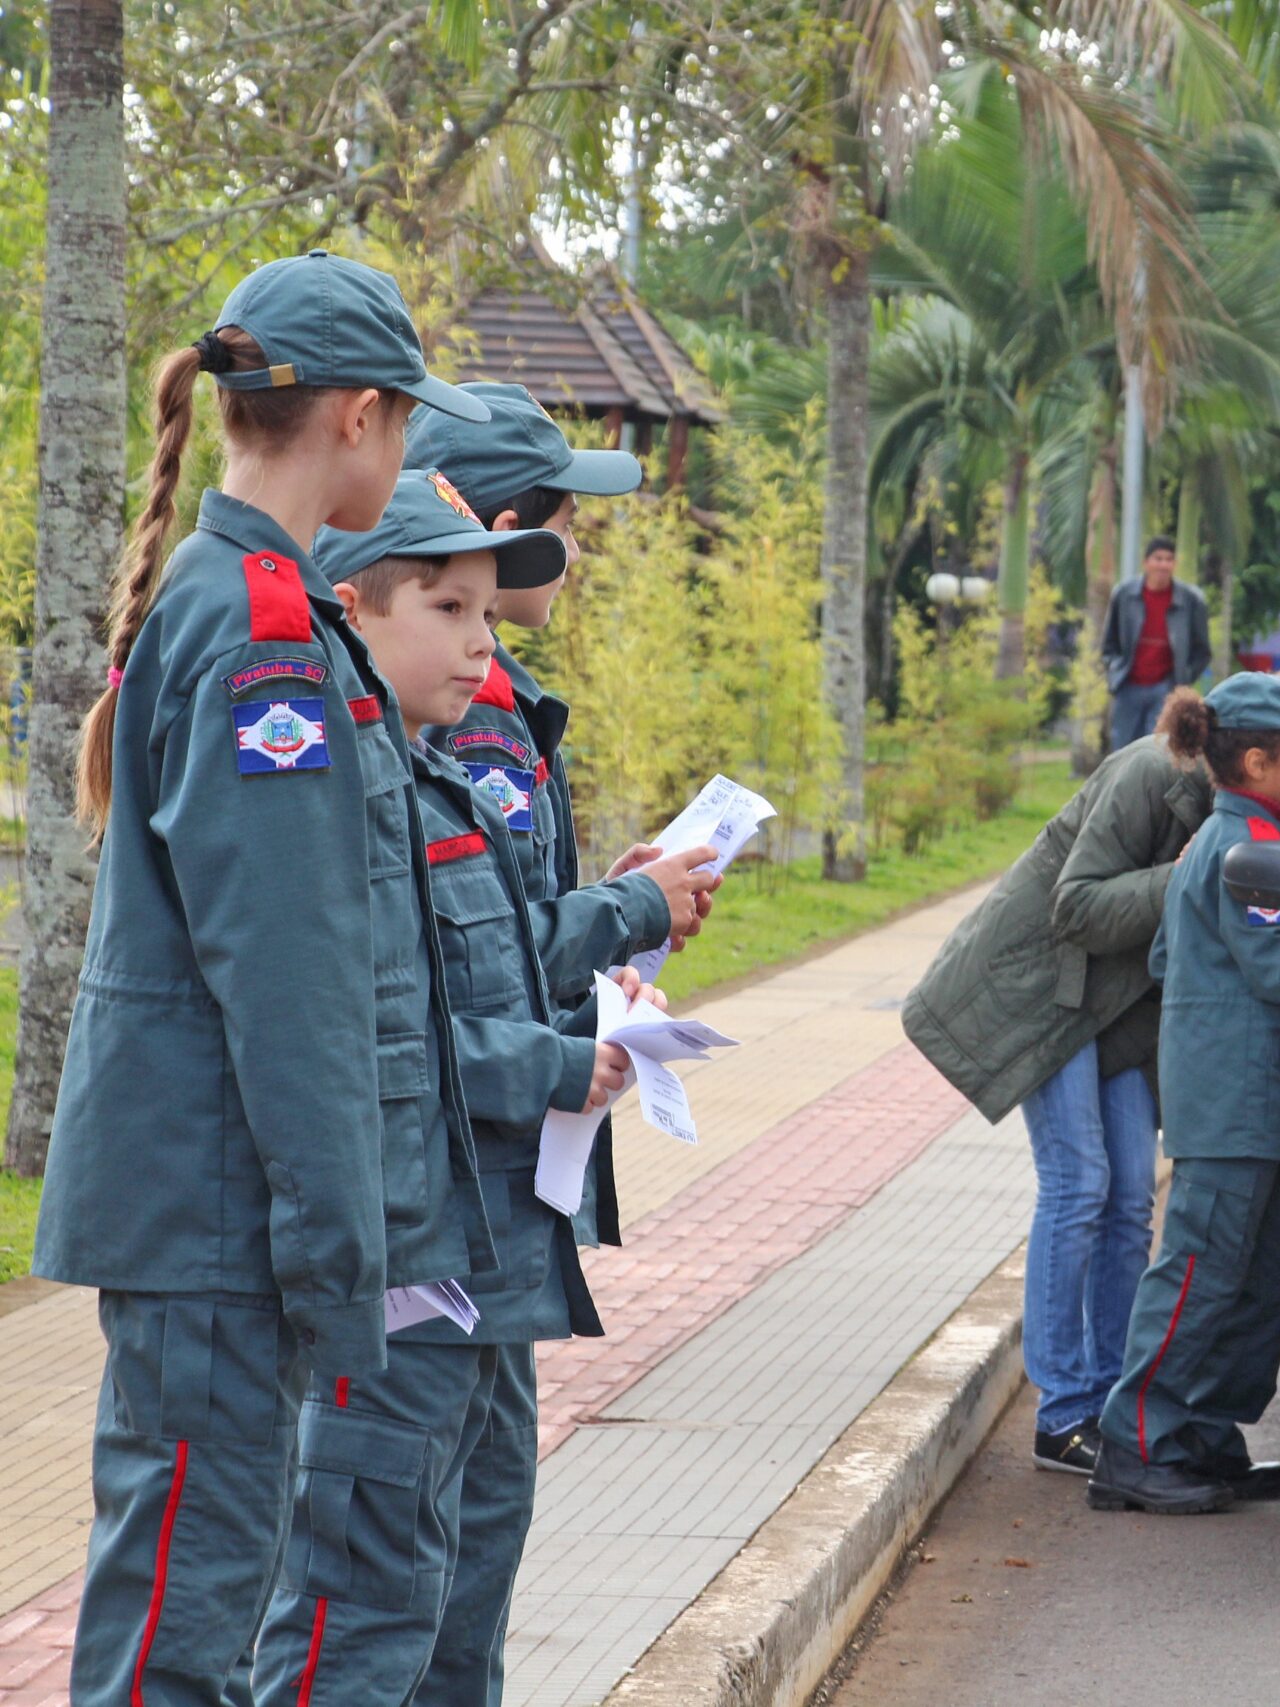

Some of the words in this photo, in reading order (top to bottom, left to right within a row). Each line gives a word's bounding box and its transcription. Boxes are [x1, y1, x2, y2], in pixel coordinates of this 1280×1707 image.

[232, 663, 293, 688] Piratuba
[304, 665, 322, 679] SC
[454, 732, 504, 747] Piratuba
